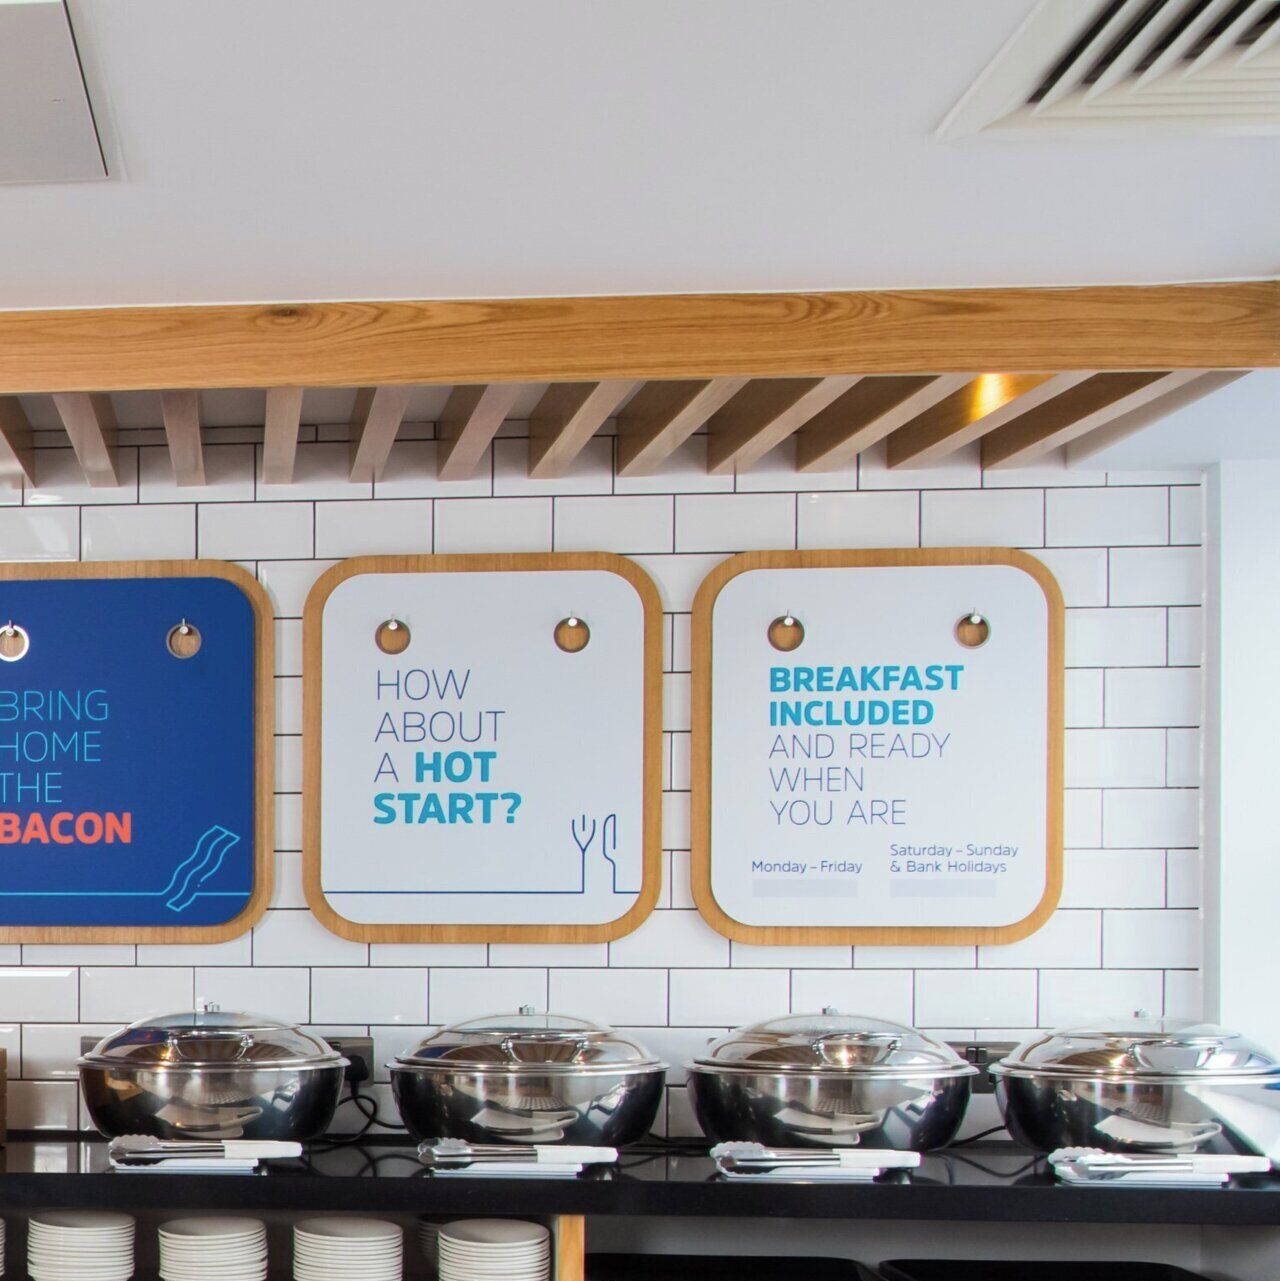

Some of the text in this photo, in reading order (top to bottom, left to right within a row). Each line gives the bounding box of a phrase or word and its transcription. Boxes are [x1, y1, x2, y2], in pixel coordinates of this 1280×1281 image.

[375, 668, 471, 701] HOW
[769, 665, 965, 693] BREAKFAST
[374, 710, 507, 743] ABOUT
[769, 699, 935, 727] INCLUDED
[768, 732, 951, 759] AND READY
[374, 750, 498, 784] A HOT
[769, 766, 864, 793] WHEN
[372, 792, 523, 826] START?
[769, 799, 907, 826] YOU ARE
[889, 843, 953, 858] Saturday
[966, 843, 1019, 858] Sunday
[889, 859, 1008, 875] & Bank Holidays
